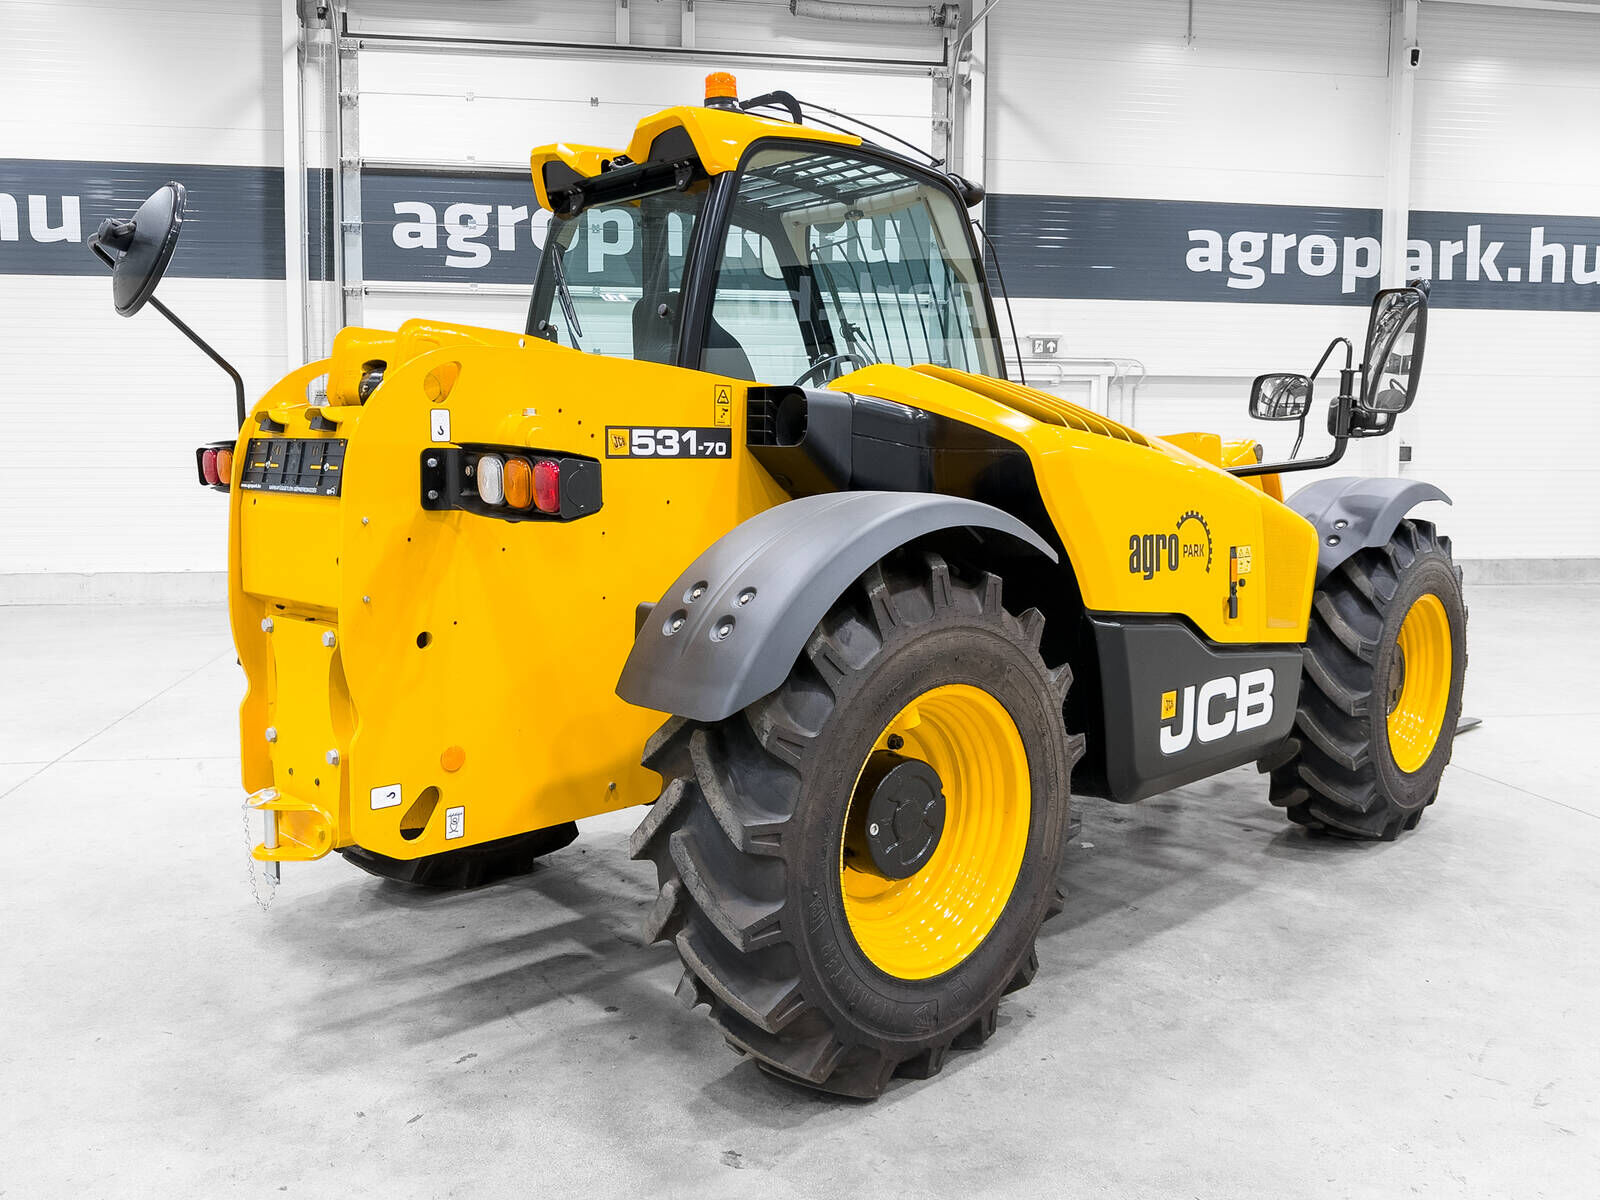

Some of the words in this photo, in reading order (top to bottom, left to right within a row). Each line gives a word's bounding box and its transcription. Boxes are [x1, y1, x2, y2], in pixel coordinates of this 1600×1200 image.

[631, 428, 727, 456] 531-70
[1129, 533, 1179, 580] agro
[1183, 543, 1204, 557] PARK
[1159, 668, 1275, 755] JCB
